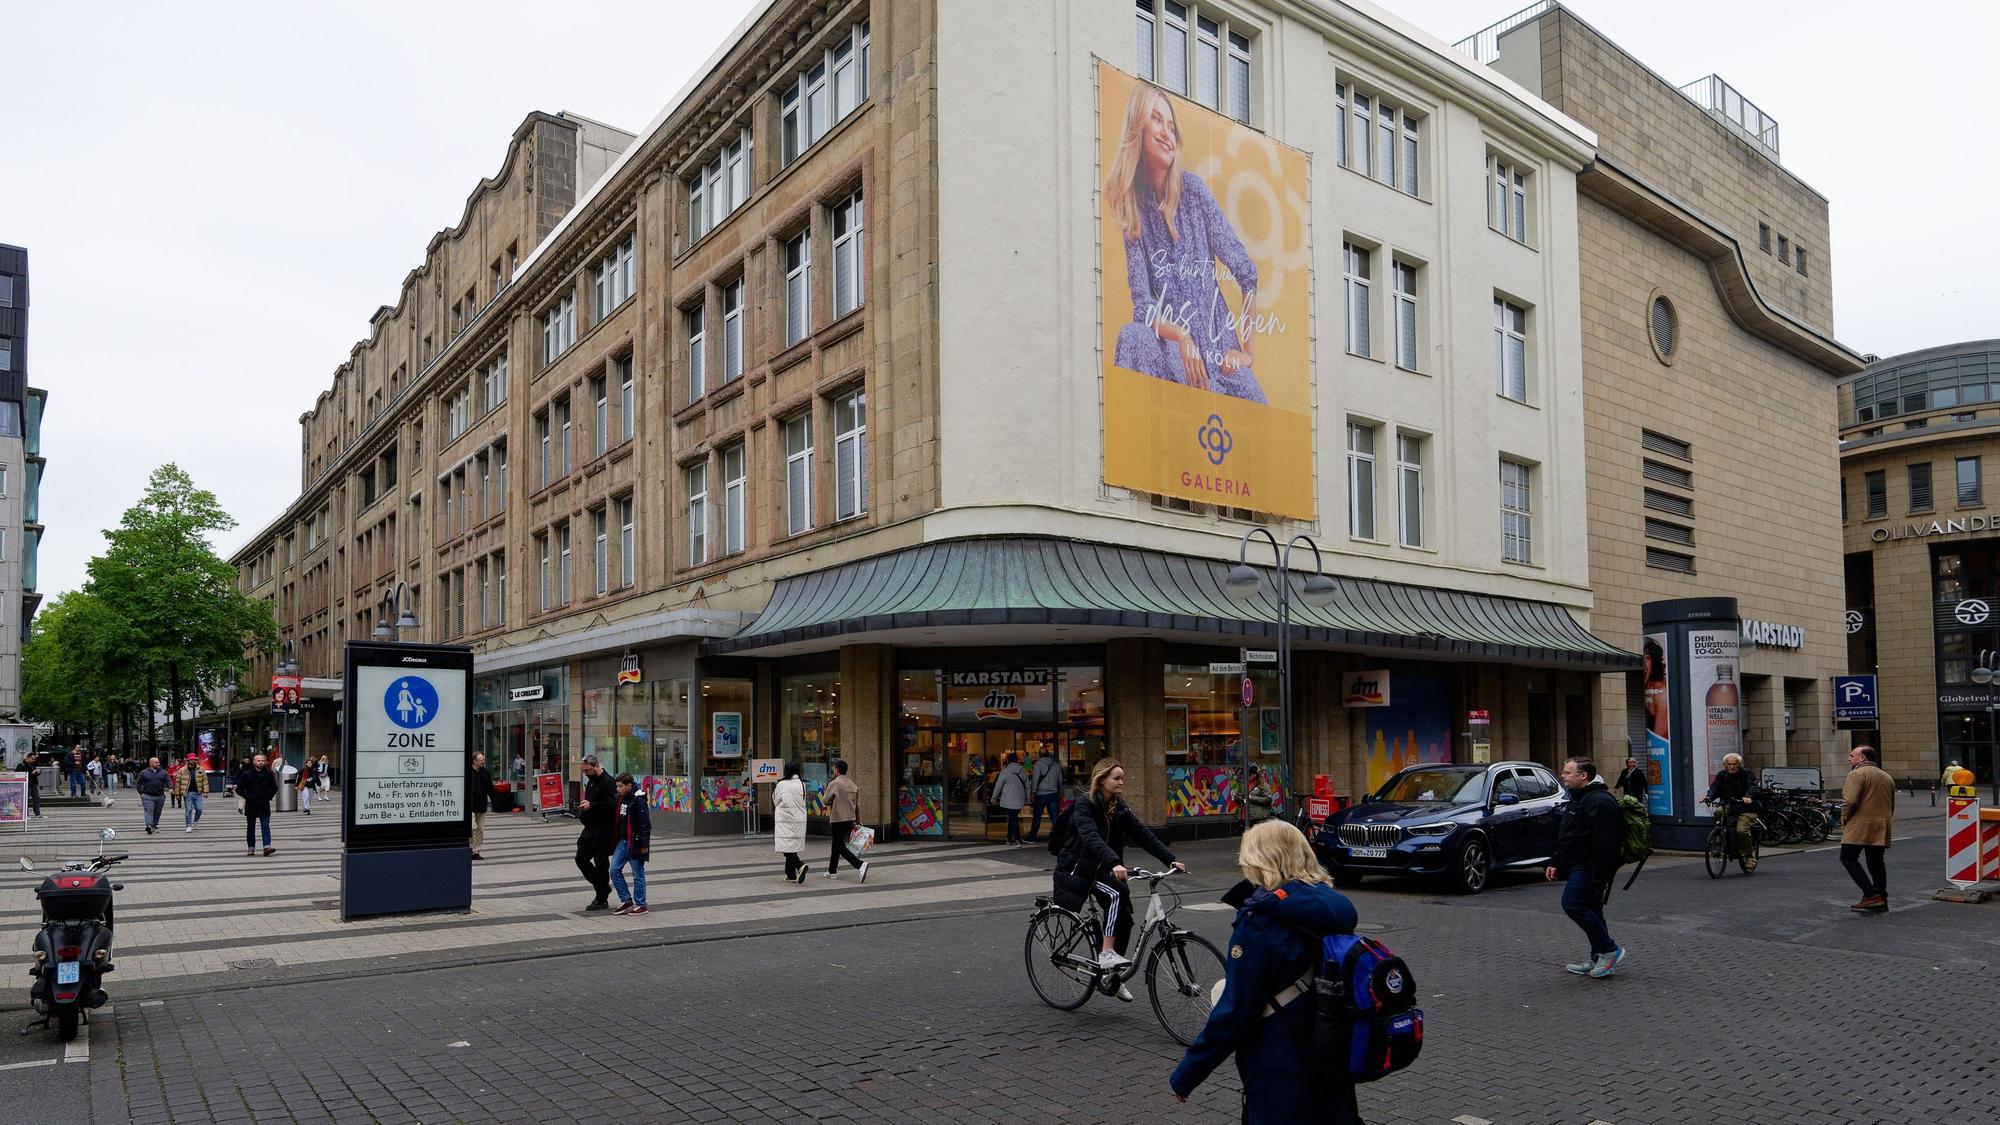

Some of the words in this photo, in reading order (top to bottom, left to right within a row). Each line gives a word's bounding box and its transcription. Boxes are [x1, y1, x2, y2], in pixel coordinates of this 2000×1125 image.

[1151, 249, 1175, 278] So
[1180, 253, 1215, 288] bunt
[1213, 264, 1236, 282] wie
[1145, 282, 1198, 340] das
[1187, 344, 1200, 359] IN
[1206, 349, 1240, 369] KÖLN
[1181, 471, 1250, 497] GALERIA
[1742, 619, 1805, 649] KARSTADT
[953, 671, 1046, 685] KARSTADT
[1352, 677, 1378, 695] dm
[984, 690, 1015, 708] dm
[1845, 686, 1862, 702] P
[387, 733, 435, 748] ZONE
[759, 762, 776, 773] dm
[378, 780, 443, 792] Lieferfahrzeuge
[368, 791, 382, 799] Mo.
[392, 790, 402, 799] Fr.
[363, 801, 405, 810] samstags
[360, 812, 378, 820] zum
[399, 811, 407, 819] u.
[409, 809, 445, 818] Entladen
[446, 808, 460, 817] frei
